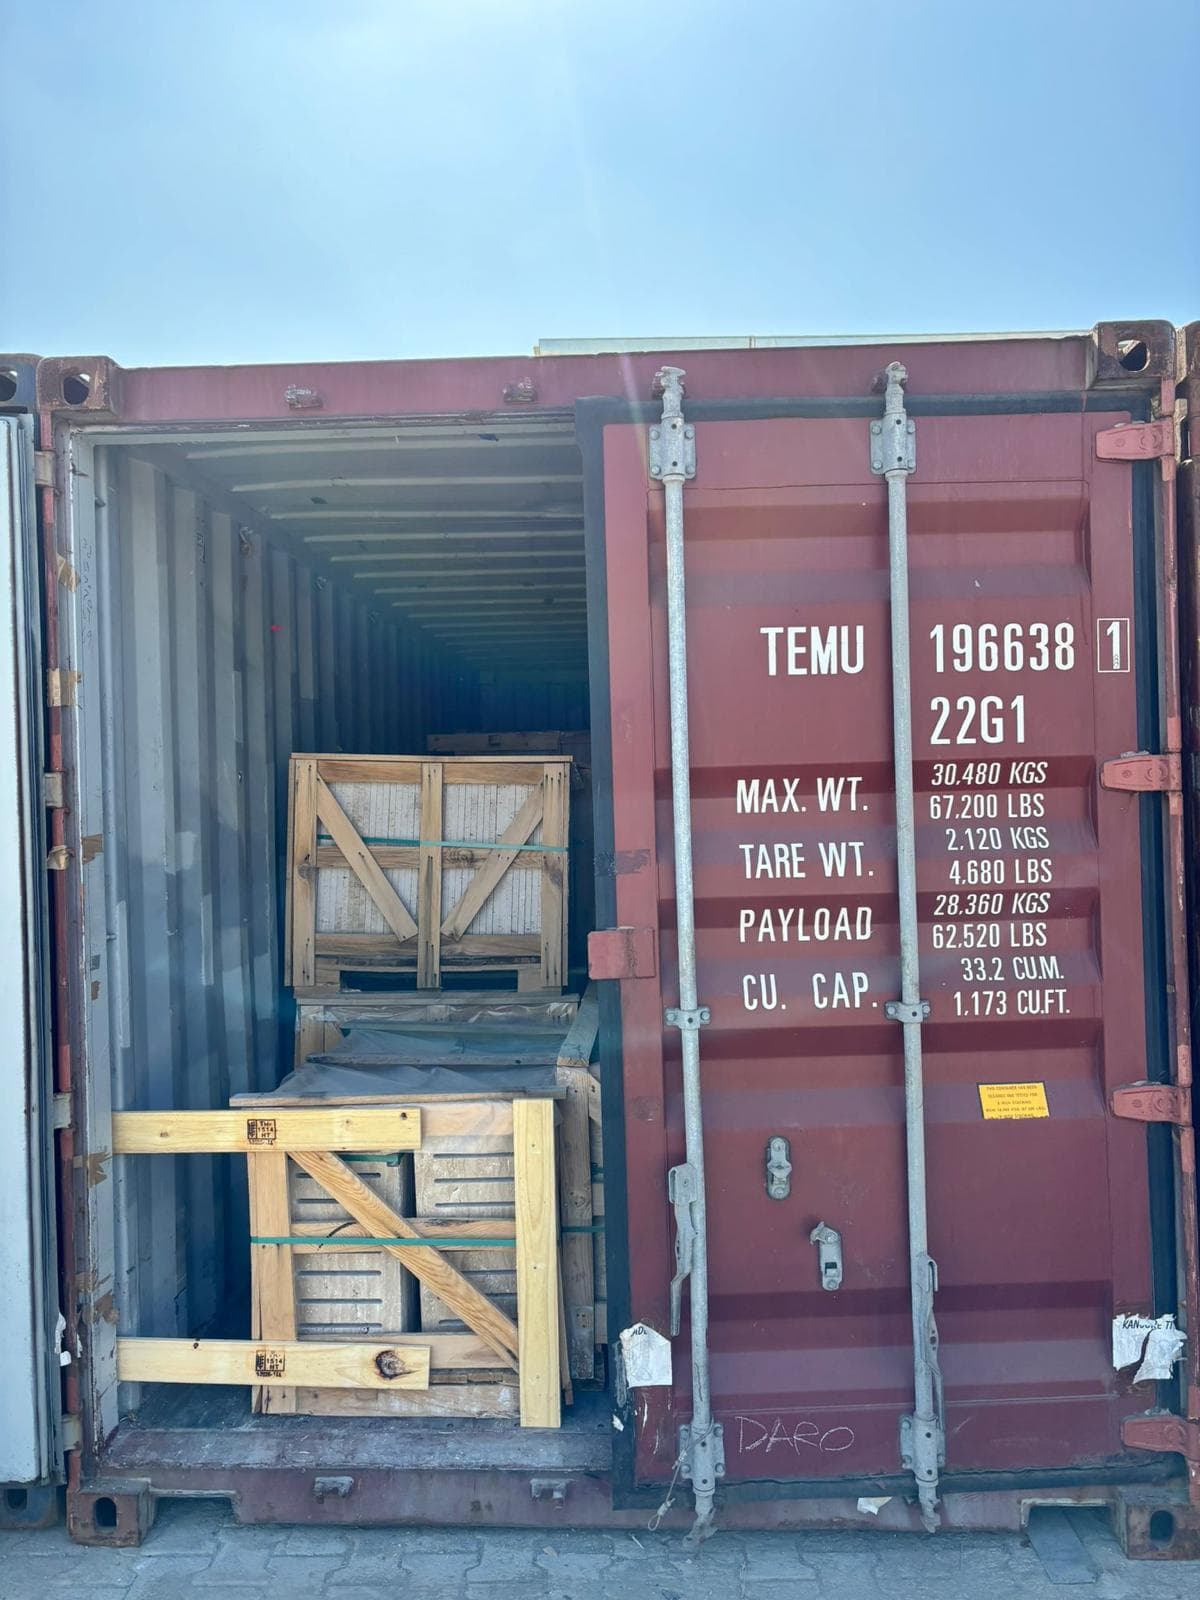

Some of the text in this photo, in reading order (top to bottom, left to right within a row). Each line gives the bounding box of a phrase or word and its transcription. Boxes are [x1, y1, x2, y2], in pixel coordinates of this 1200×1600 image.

[759, 621, 1121, 676] TEMU 196638 1
[930, 694, 1025, 745] 22G1
[931, 761, 1048, 786] 30,480 KGS
[736, 776, 868, 814] MAX. WT.
[930, 793, 1045, 820] 67,200 LBS
[945, 826, 1050, 851] 2,120 KGS
[738, 841, 874, 879] TARE WT.
[949, 858, 1053, 885] 4,680 LBS
[933, 892, 1051, 916] 28,360 KGS
[739, 906, 872, 943] PAYLOAD
[932, 922, 1047, 949] 62,520 LBS
[960, 955, 1065, 982] 33.2 CU.M.
[742, 971, 878, 1011] CU. CAP.
[953, 988, 1070, 1016] 1,173 CU.FT.
[734, 1415, 856, 1456] DARO
